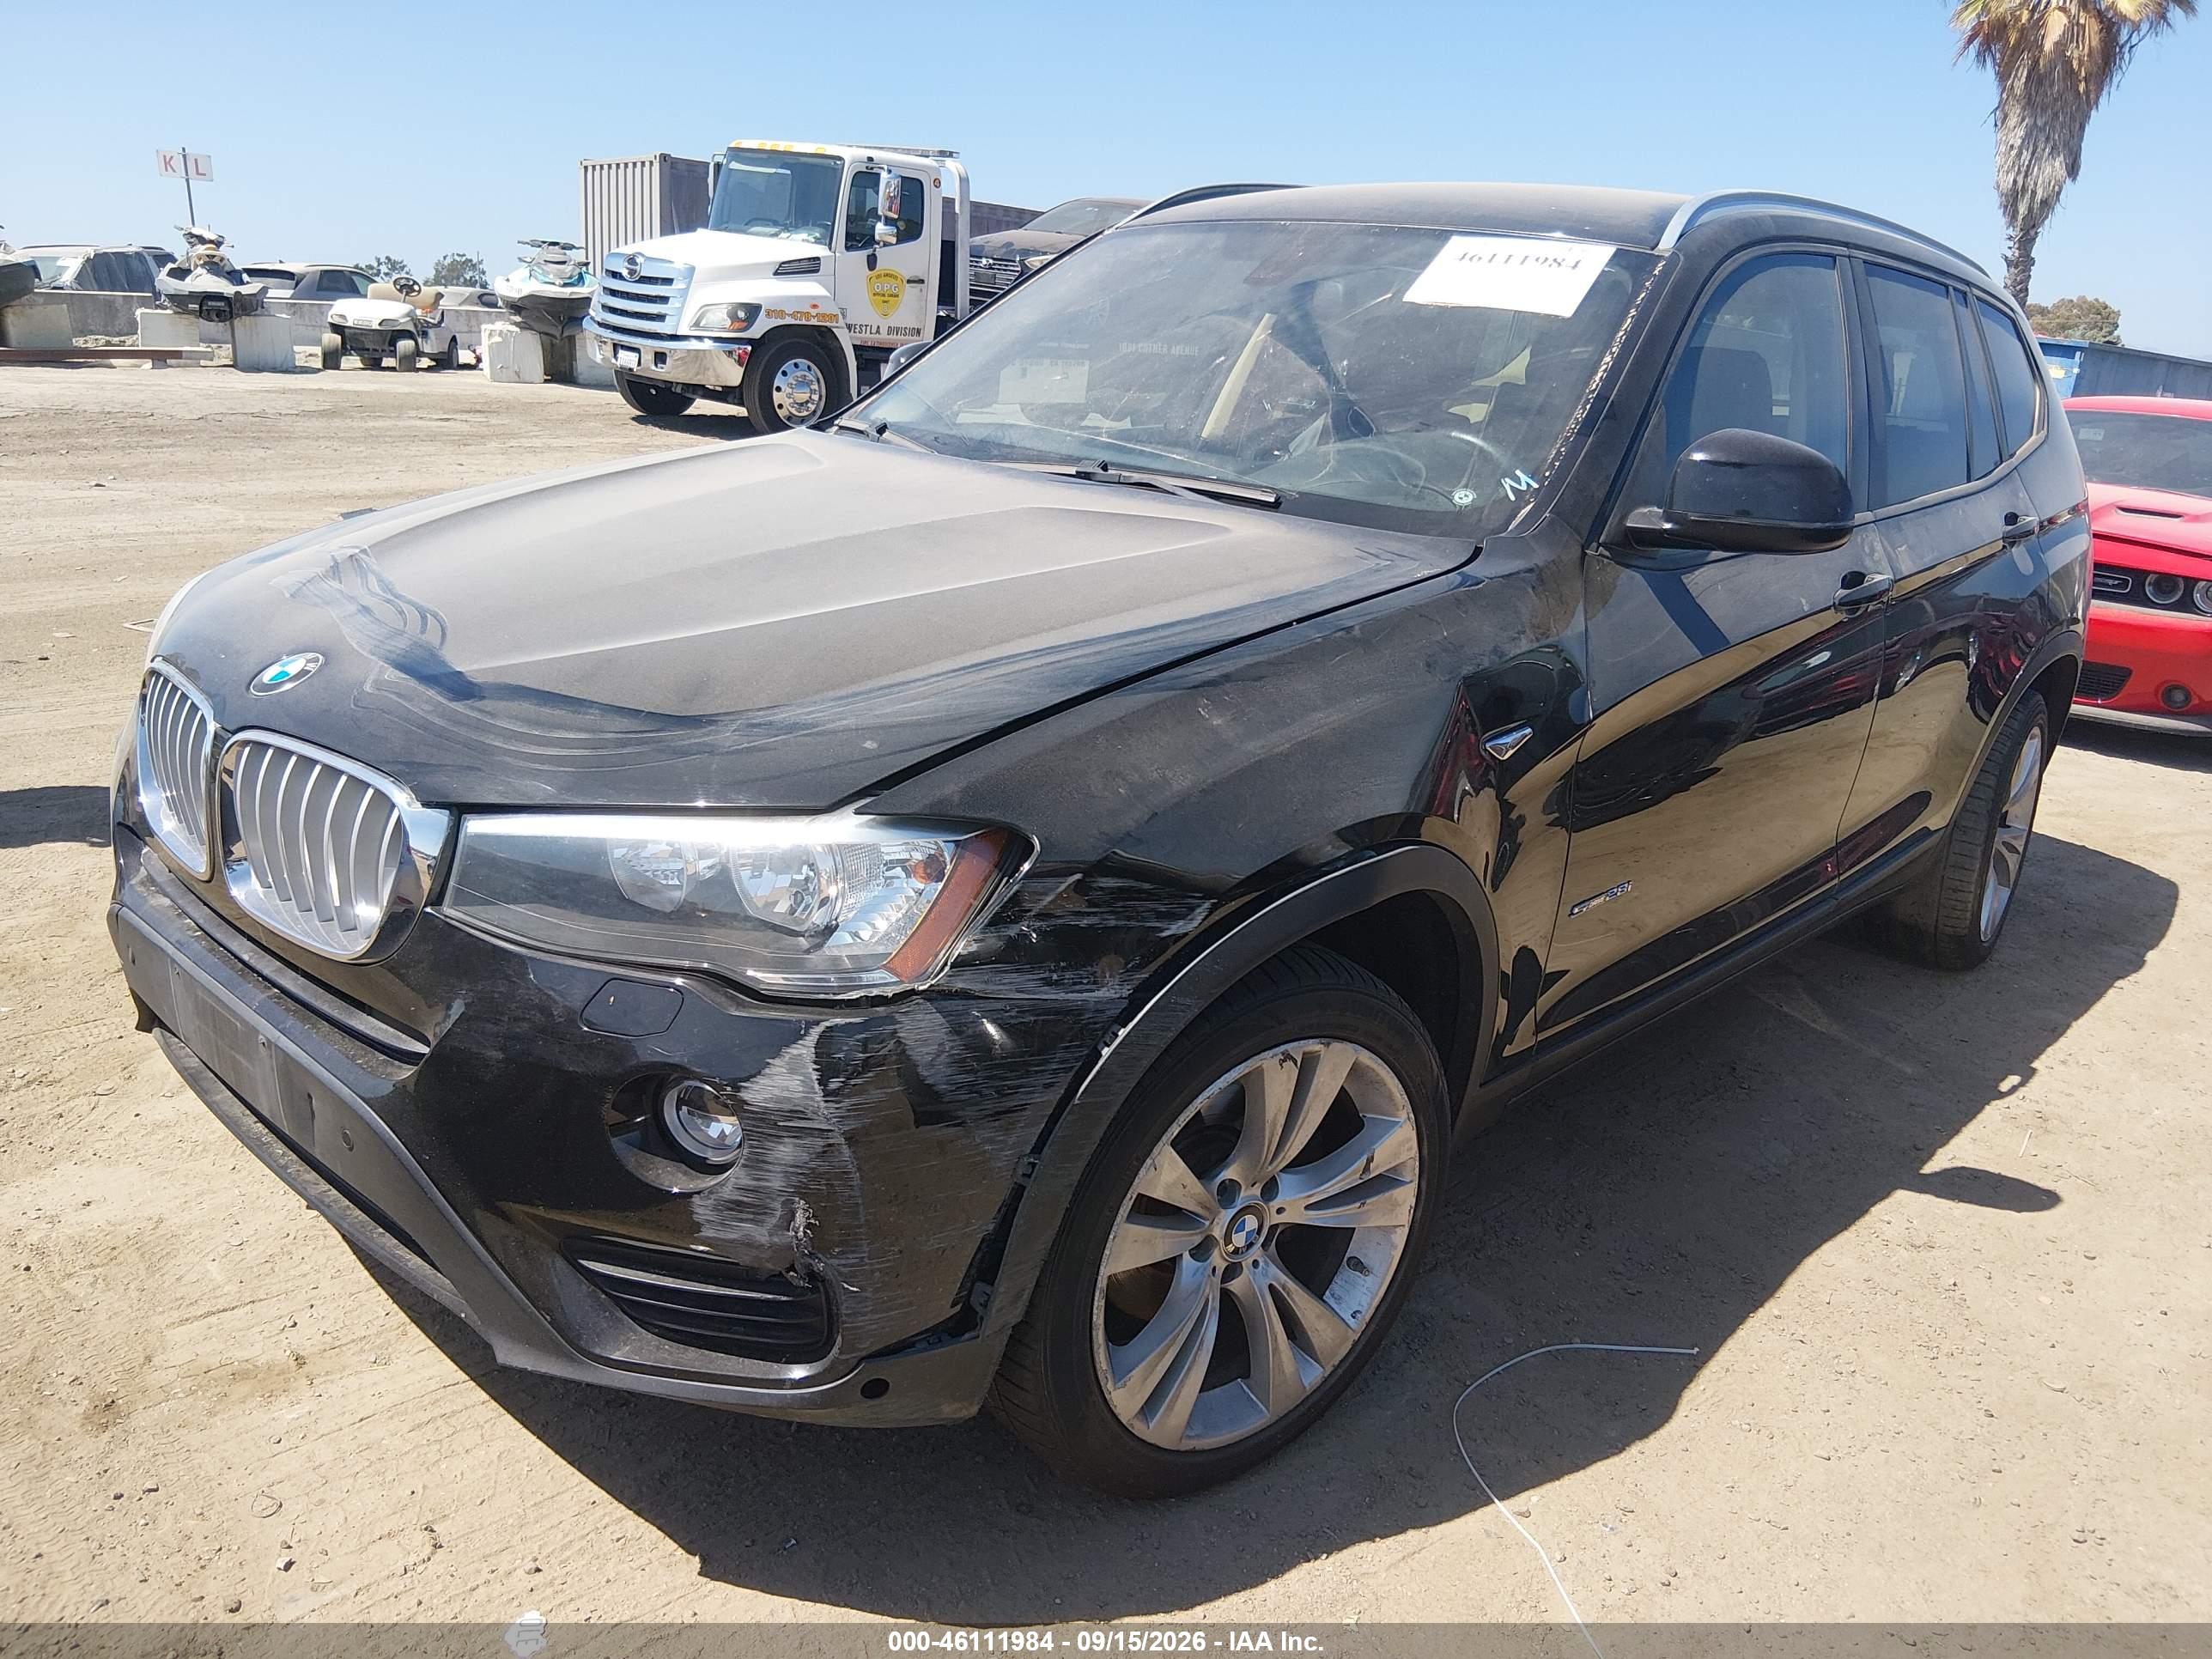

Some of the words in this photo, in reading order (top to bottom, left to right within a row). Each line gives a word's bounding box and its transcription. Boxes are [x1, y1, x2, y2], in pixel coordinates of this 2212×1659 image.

[162, 155, 178, 173] K
[194, 158, 207, 176] L
[1455, 252, 1583, 270] 46111984
[887, 325, 922, 337] DIVISION
[1170, 344, 1200, 356] AVENUE
